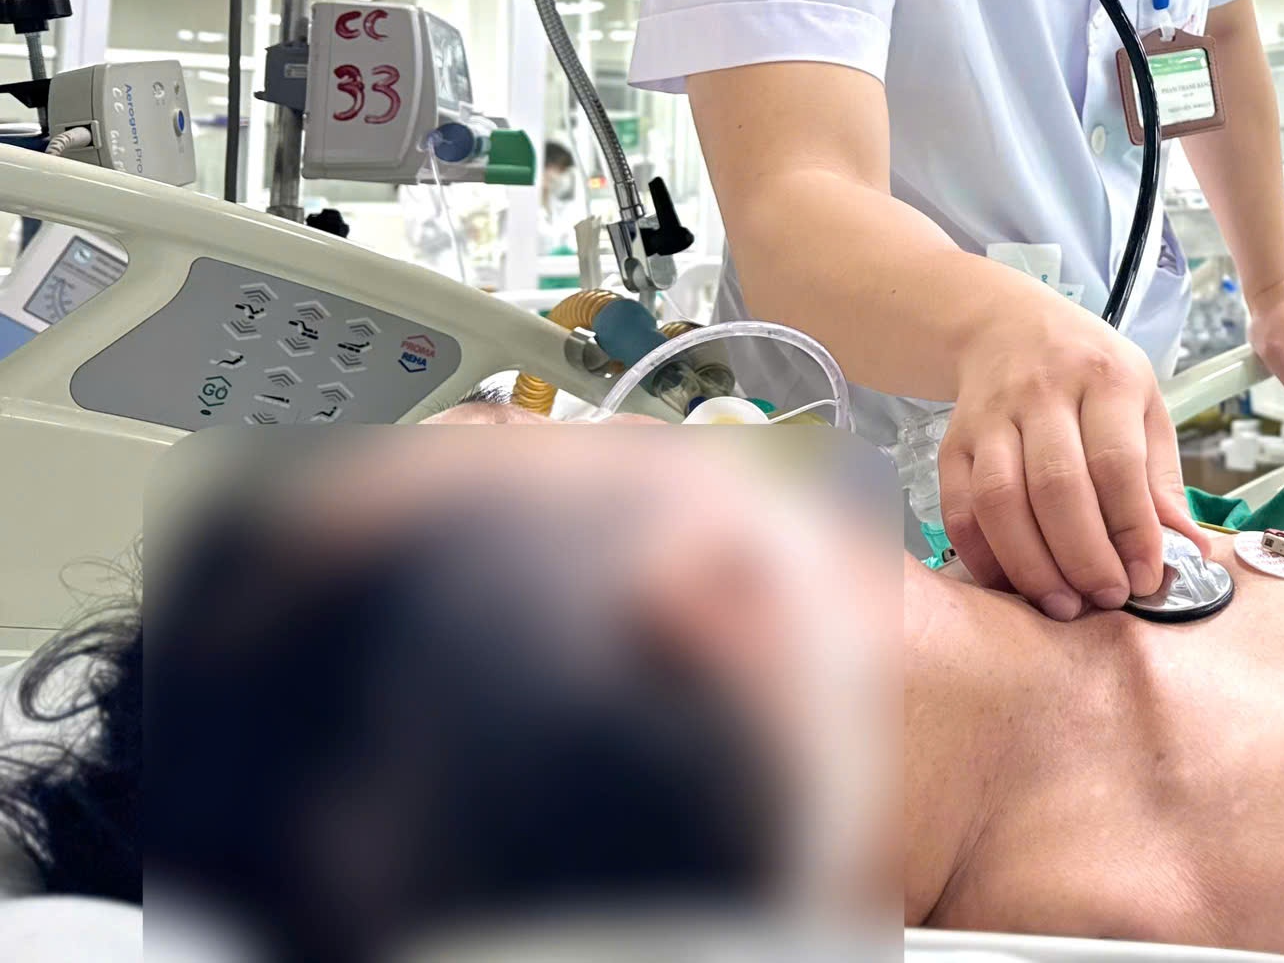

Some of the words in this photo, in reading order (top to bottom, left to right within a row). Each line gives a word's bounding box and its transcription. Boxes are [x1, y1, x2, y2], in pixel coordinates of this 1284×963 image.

[335, 9, 389, 41] CC
[332, 64, 402, 124] 33
[123, 83, 139, 145] Aerogen
[135, 147, 143, 173] Pro
[401, 340, 436, 358] PROMA
[401, 351, 427, 367] REHA
